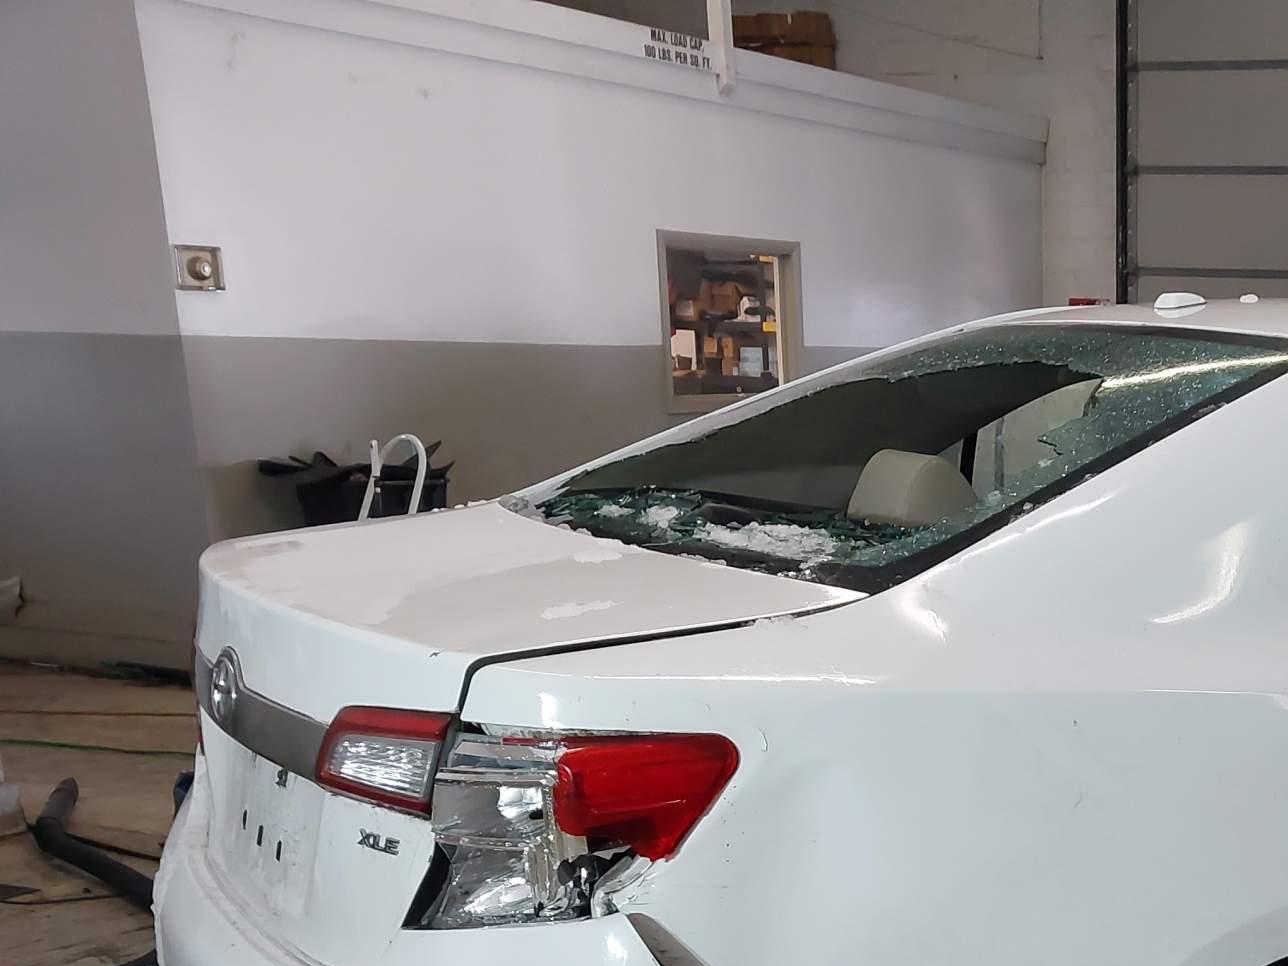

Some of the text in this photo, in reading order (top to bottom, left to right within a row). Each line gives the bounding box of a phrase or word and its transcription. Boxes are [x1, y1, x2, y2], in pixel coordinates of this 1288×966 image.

[671, 32, 688, 48] LOAD
[643, 44, 657, 59] 100
[675, 51, 688, 65] PER
[356, 828, 401, 856] XLE
